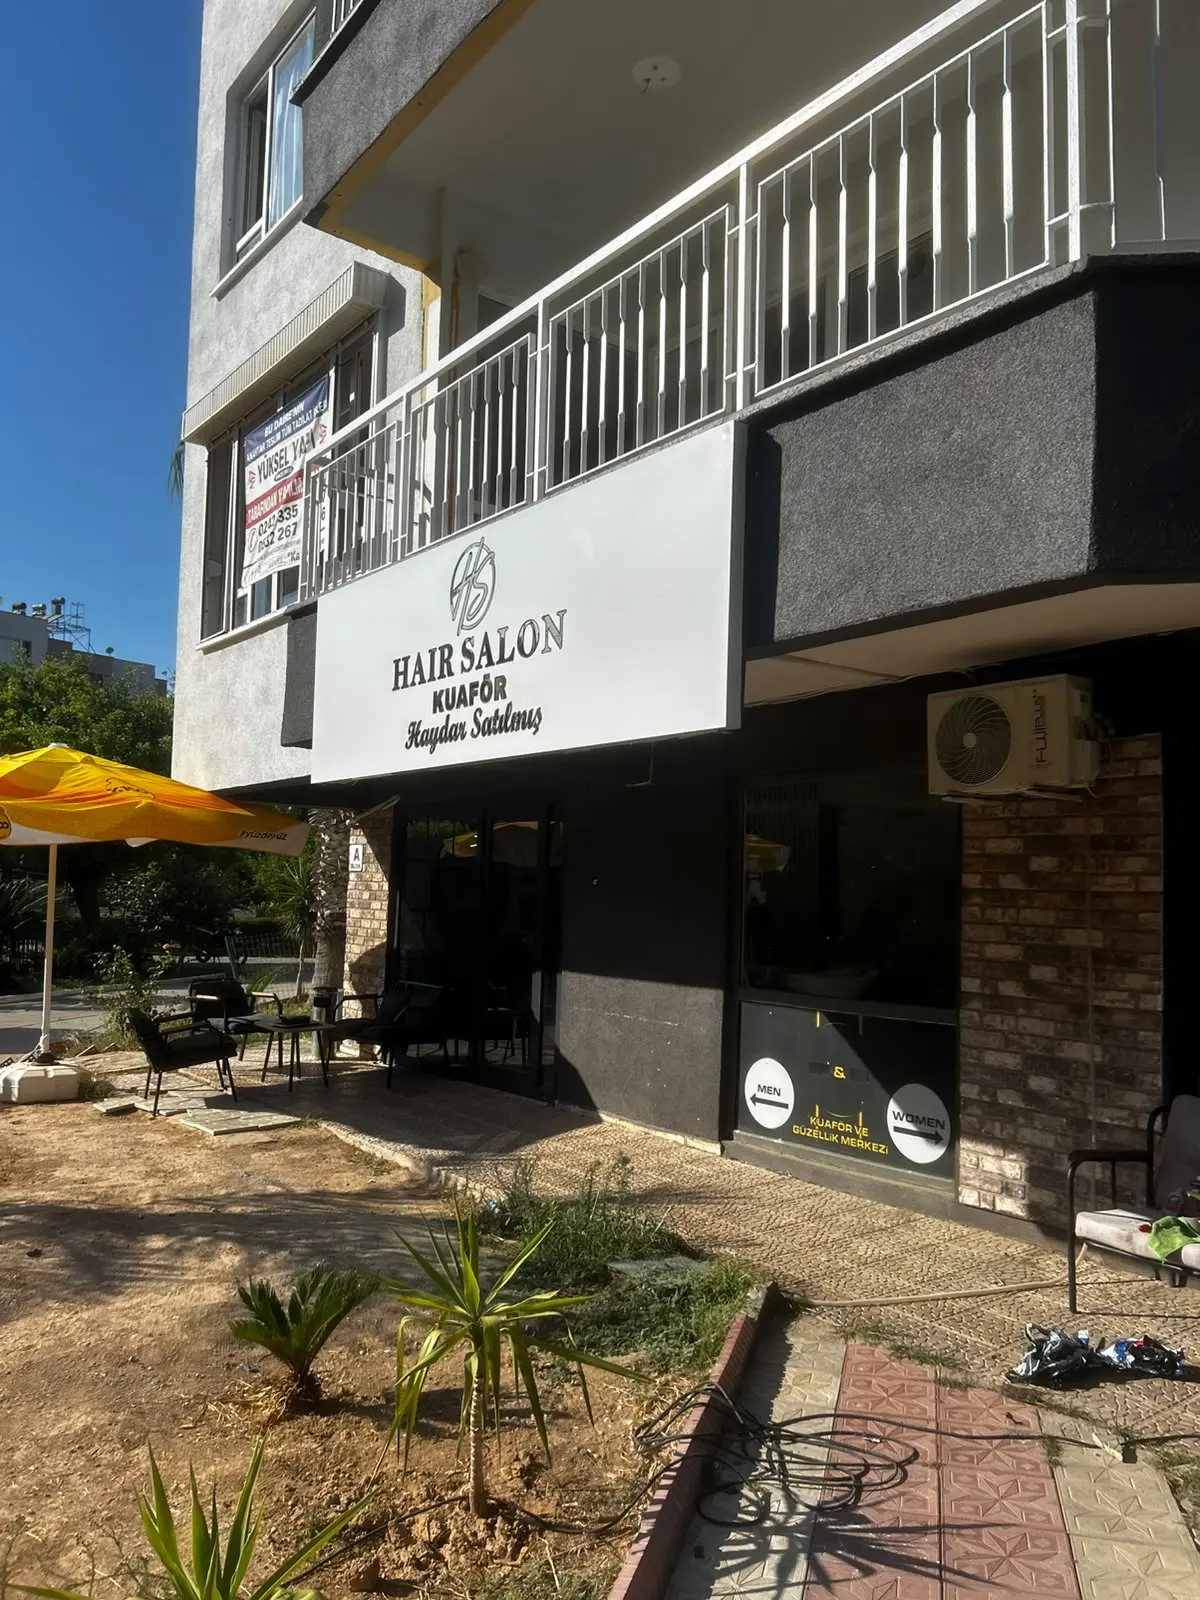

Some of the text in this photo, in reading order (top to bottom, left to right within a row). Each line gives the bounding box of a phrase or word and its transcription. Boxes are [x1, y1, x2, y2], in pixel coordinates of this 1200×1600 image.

[257, 446, 289, 483] YÜKSEL
[277, 504, 298, 523] 335
[277, 522, 298, 541] 267
[392, 609, 567, 691] HAIR SALON
[432, 673, 508, 714] KUAFÖR
[405, 701, 543, 755] Haydar Satılmış
[353, 847, 361, 861] A
[833, 1066, 846, 1079] &
[757, 1084, 781, 1097] MEN
[892, 1110, 946, 1130] WOMEN
[854, 1125, 869, 1137] VE
